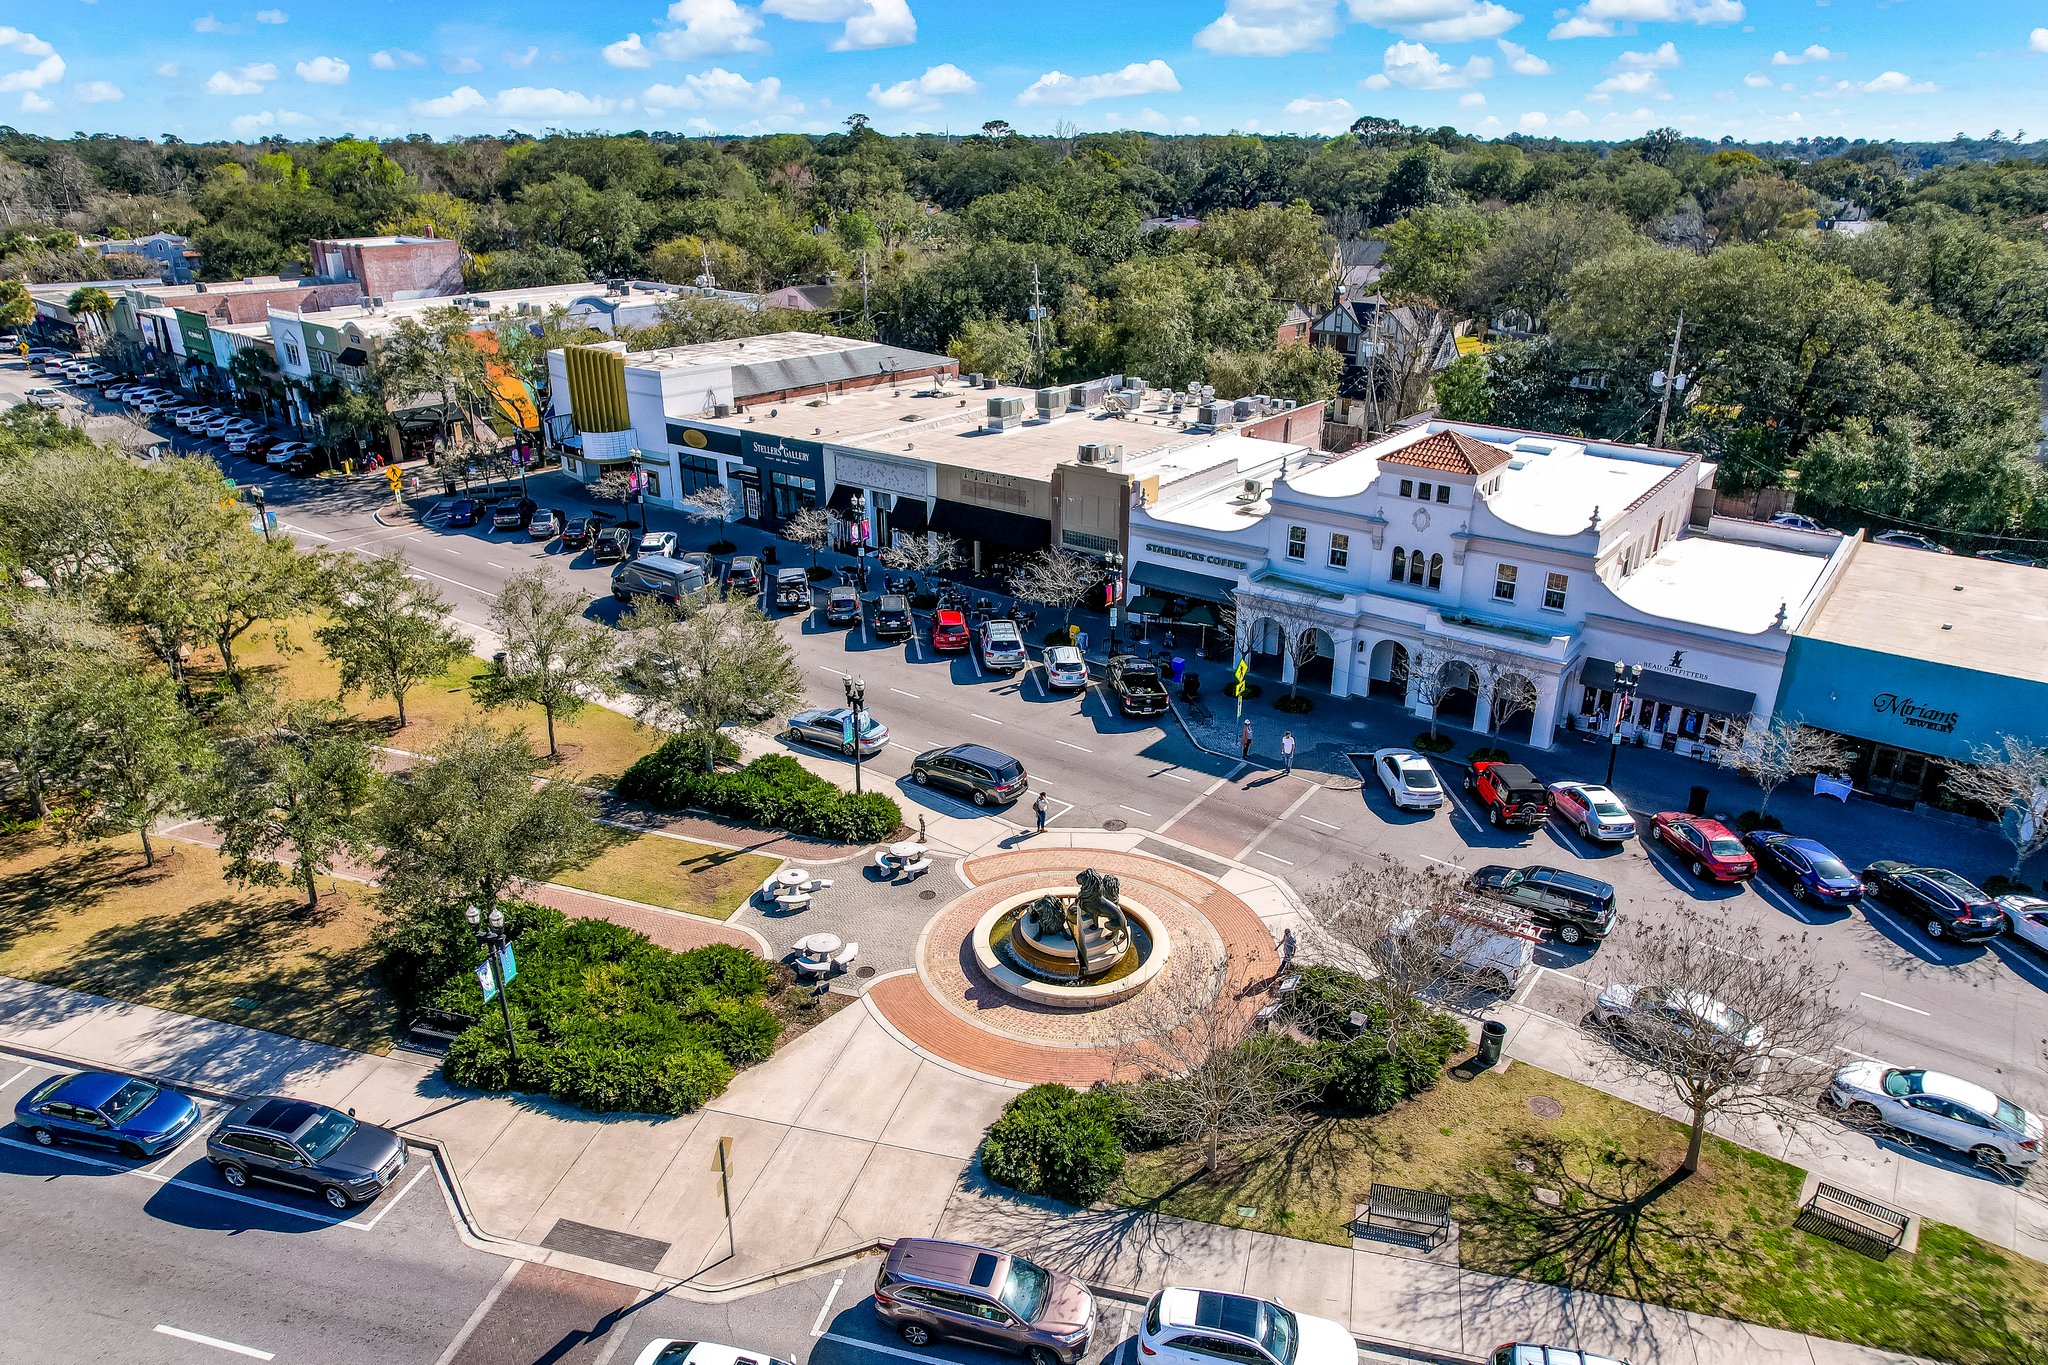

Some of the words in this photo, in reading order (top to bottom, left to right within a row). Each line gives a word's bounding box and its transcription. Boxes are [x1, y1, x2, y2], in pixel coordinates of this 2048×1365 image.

[783, 447, 810, 461] GALLERY
[1145, 543, 1205, 562] STARBUCKS
[1206, 555, 1248, 570] COFFEE
[1643, 661, 1662, 670] BEAU
[1663, 666, 1709, 680] OUTFITTERS
[1903, 717, 1954, 733] JEWELRY
